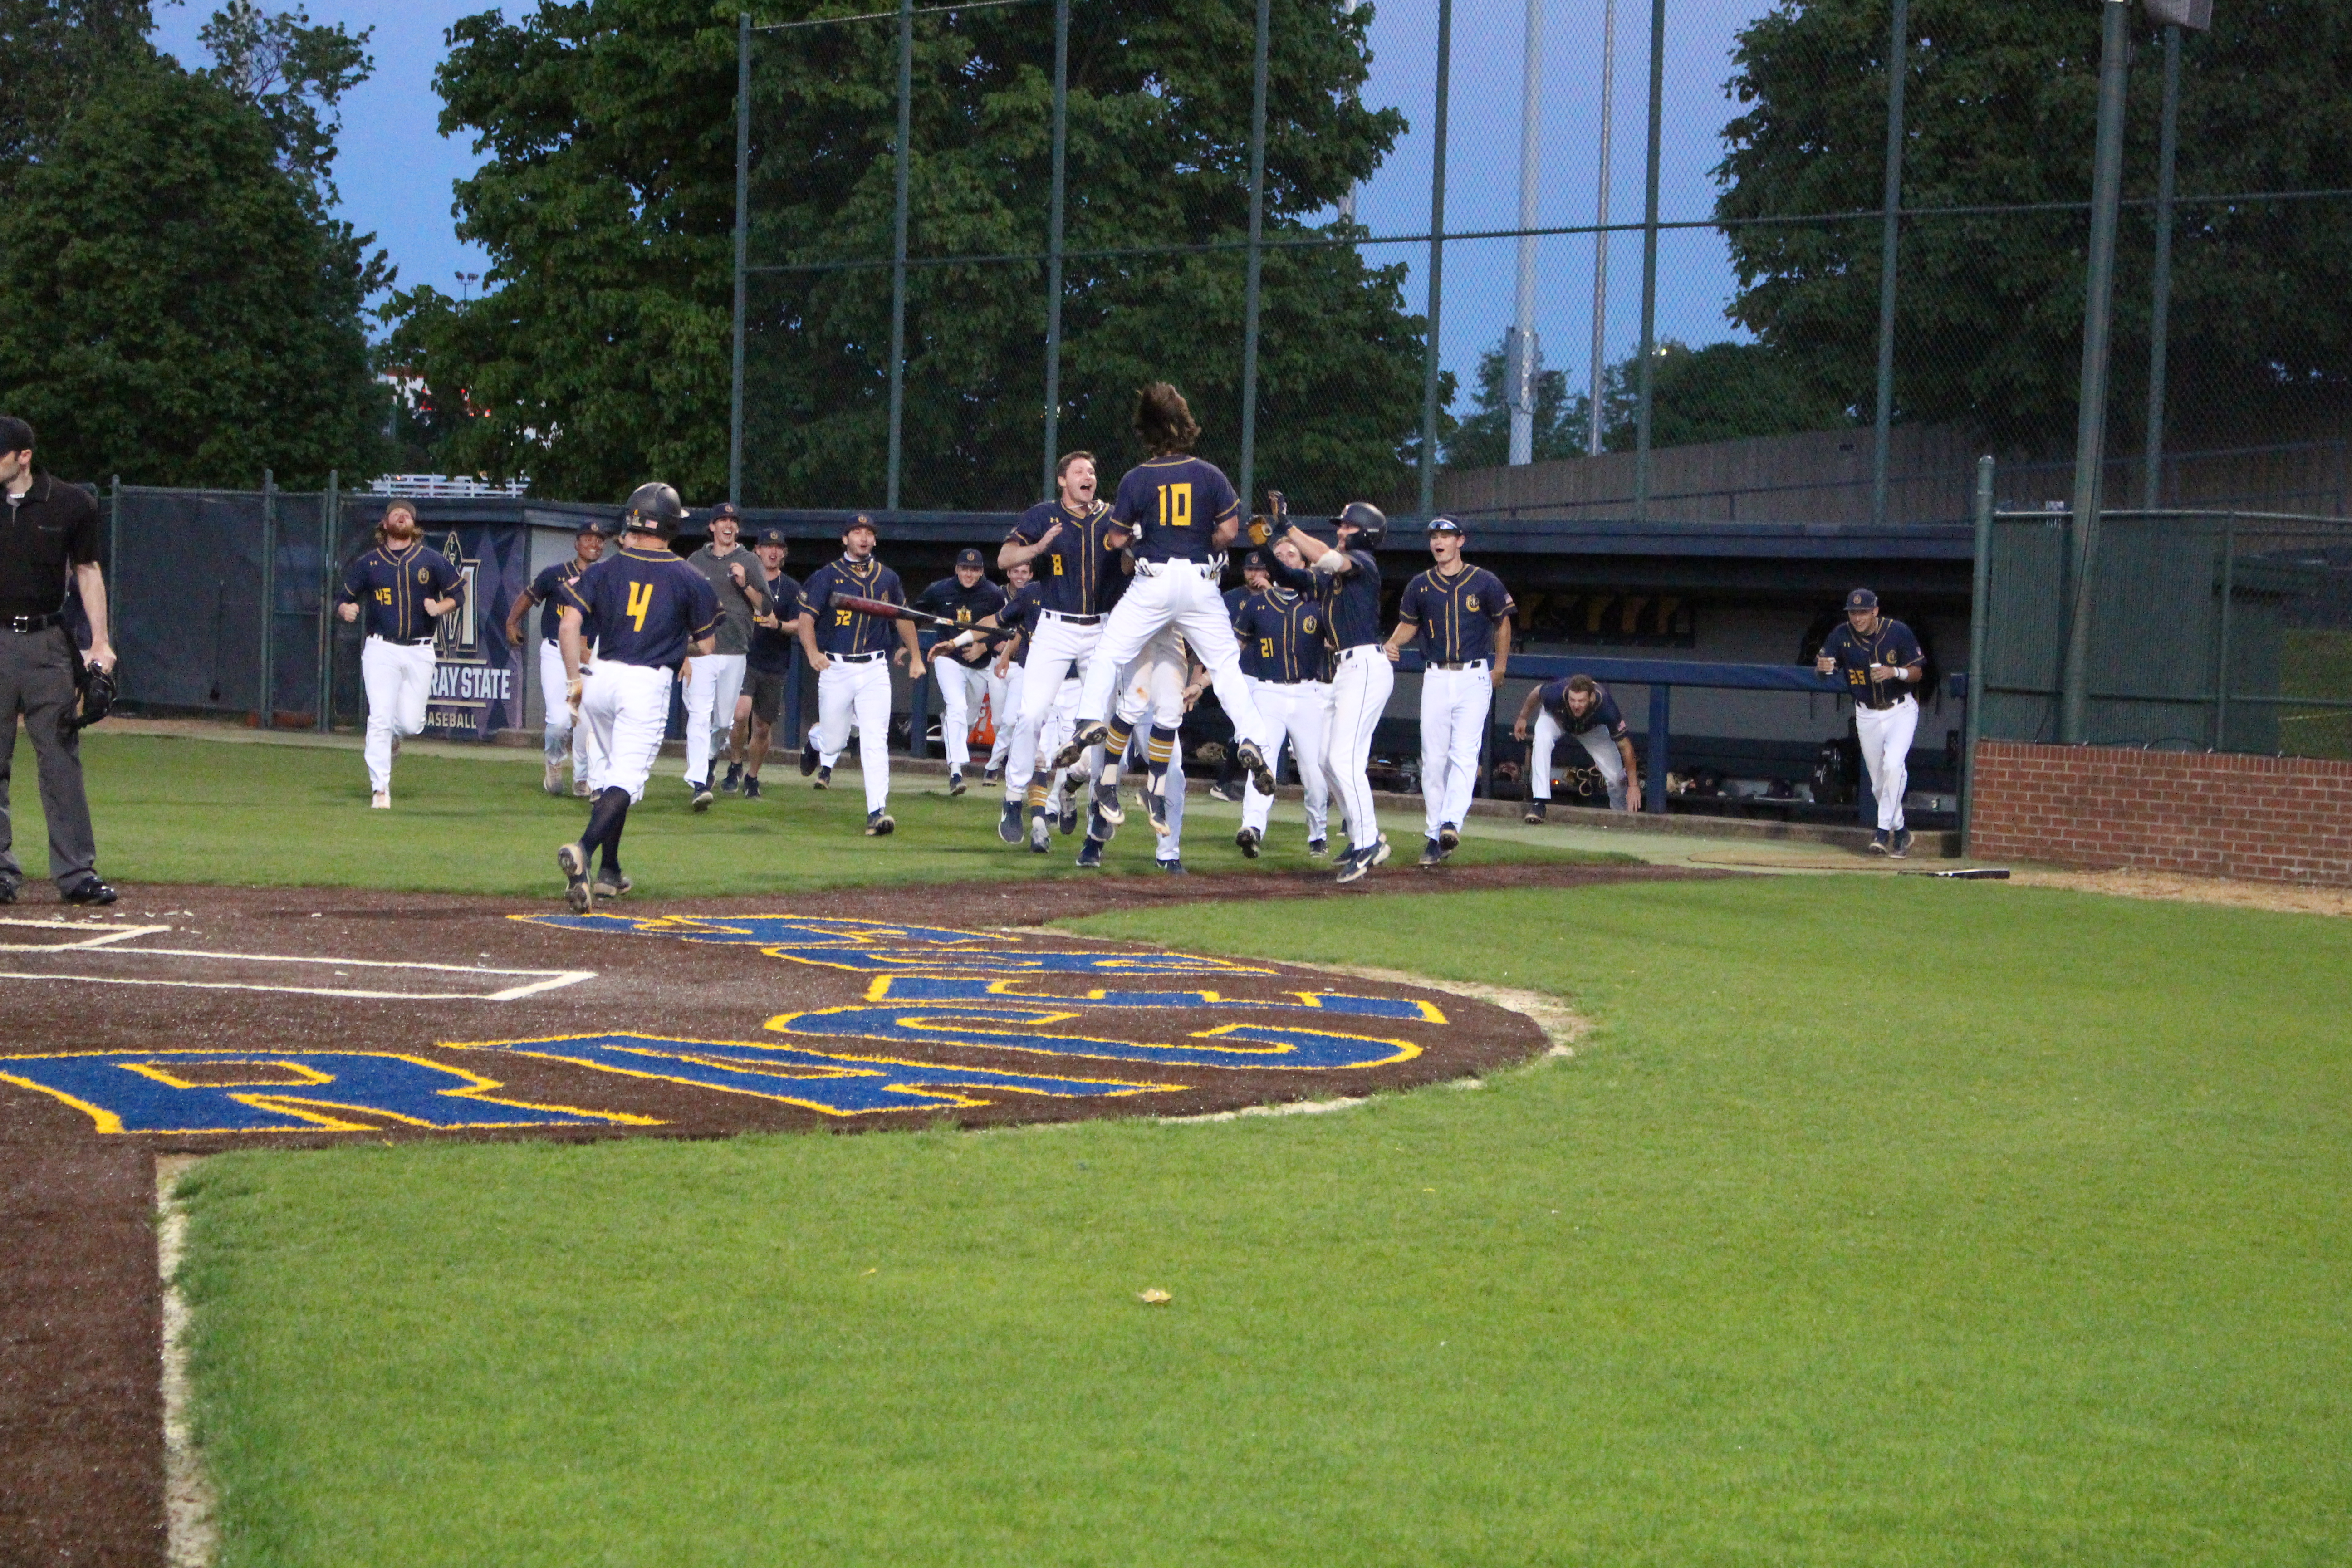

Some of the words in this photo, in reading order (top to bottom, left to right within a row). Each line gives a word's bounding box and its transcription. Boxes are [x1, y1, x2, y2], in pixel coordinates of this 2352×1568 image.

[1157, 483, 1191, 526] 10
[1051, 554, 1063, 576] 8
[374, 587, 392, 605] 45
[626, 581, 654, 632] 4
[1428, 619, 1435, 639] 1
[1259, 637, 1274, 658] 21
[461, 667, 511, 700] STATE
[1848, 669, 1866, 685] 35
[424, 711, 476, 729] ASEBALL
